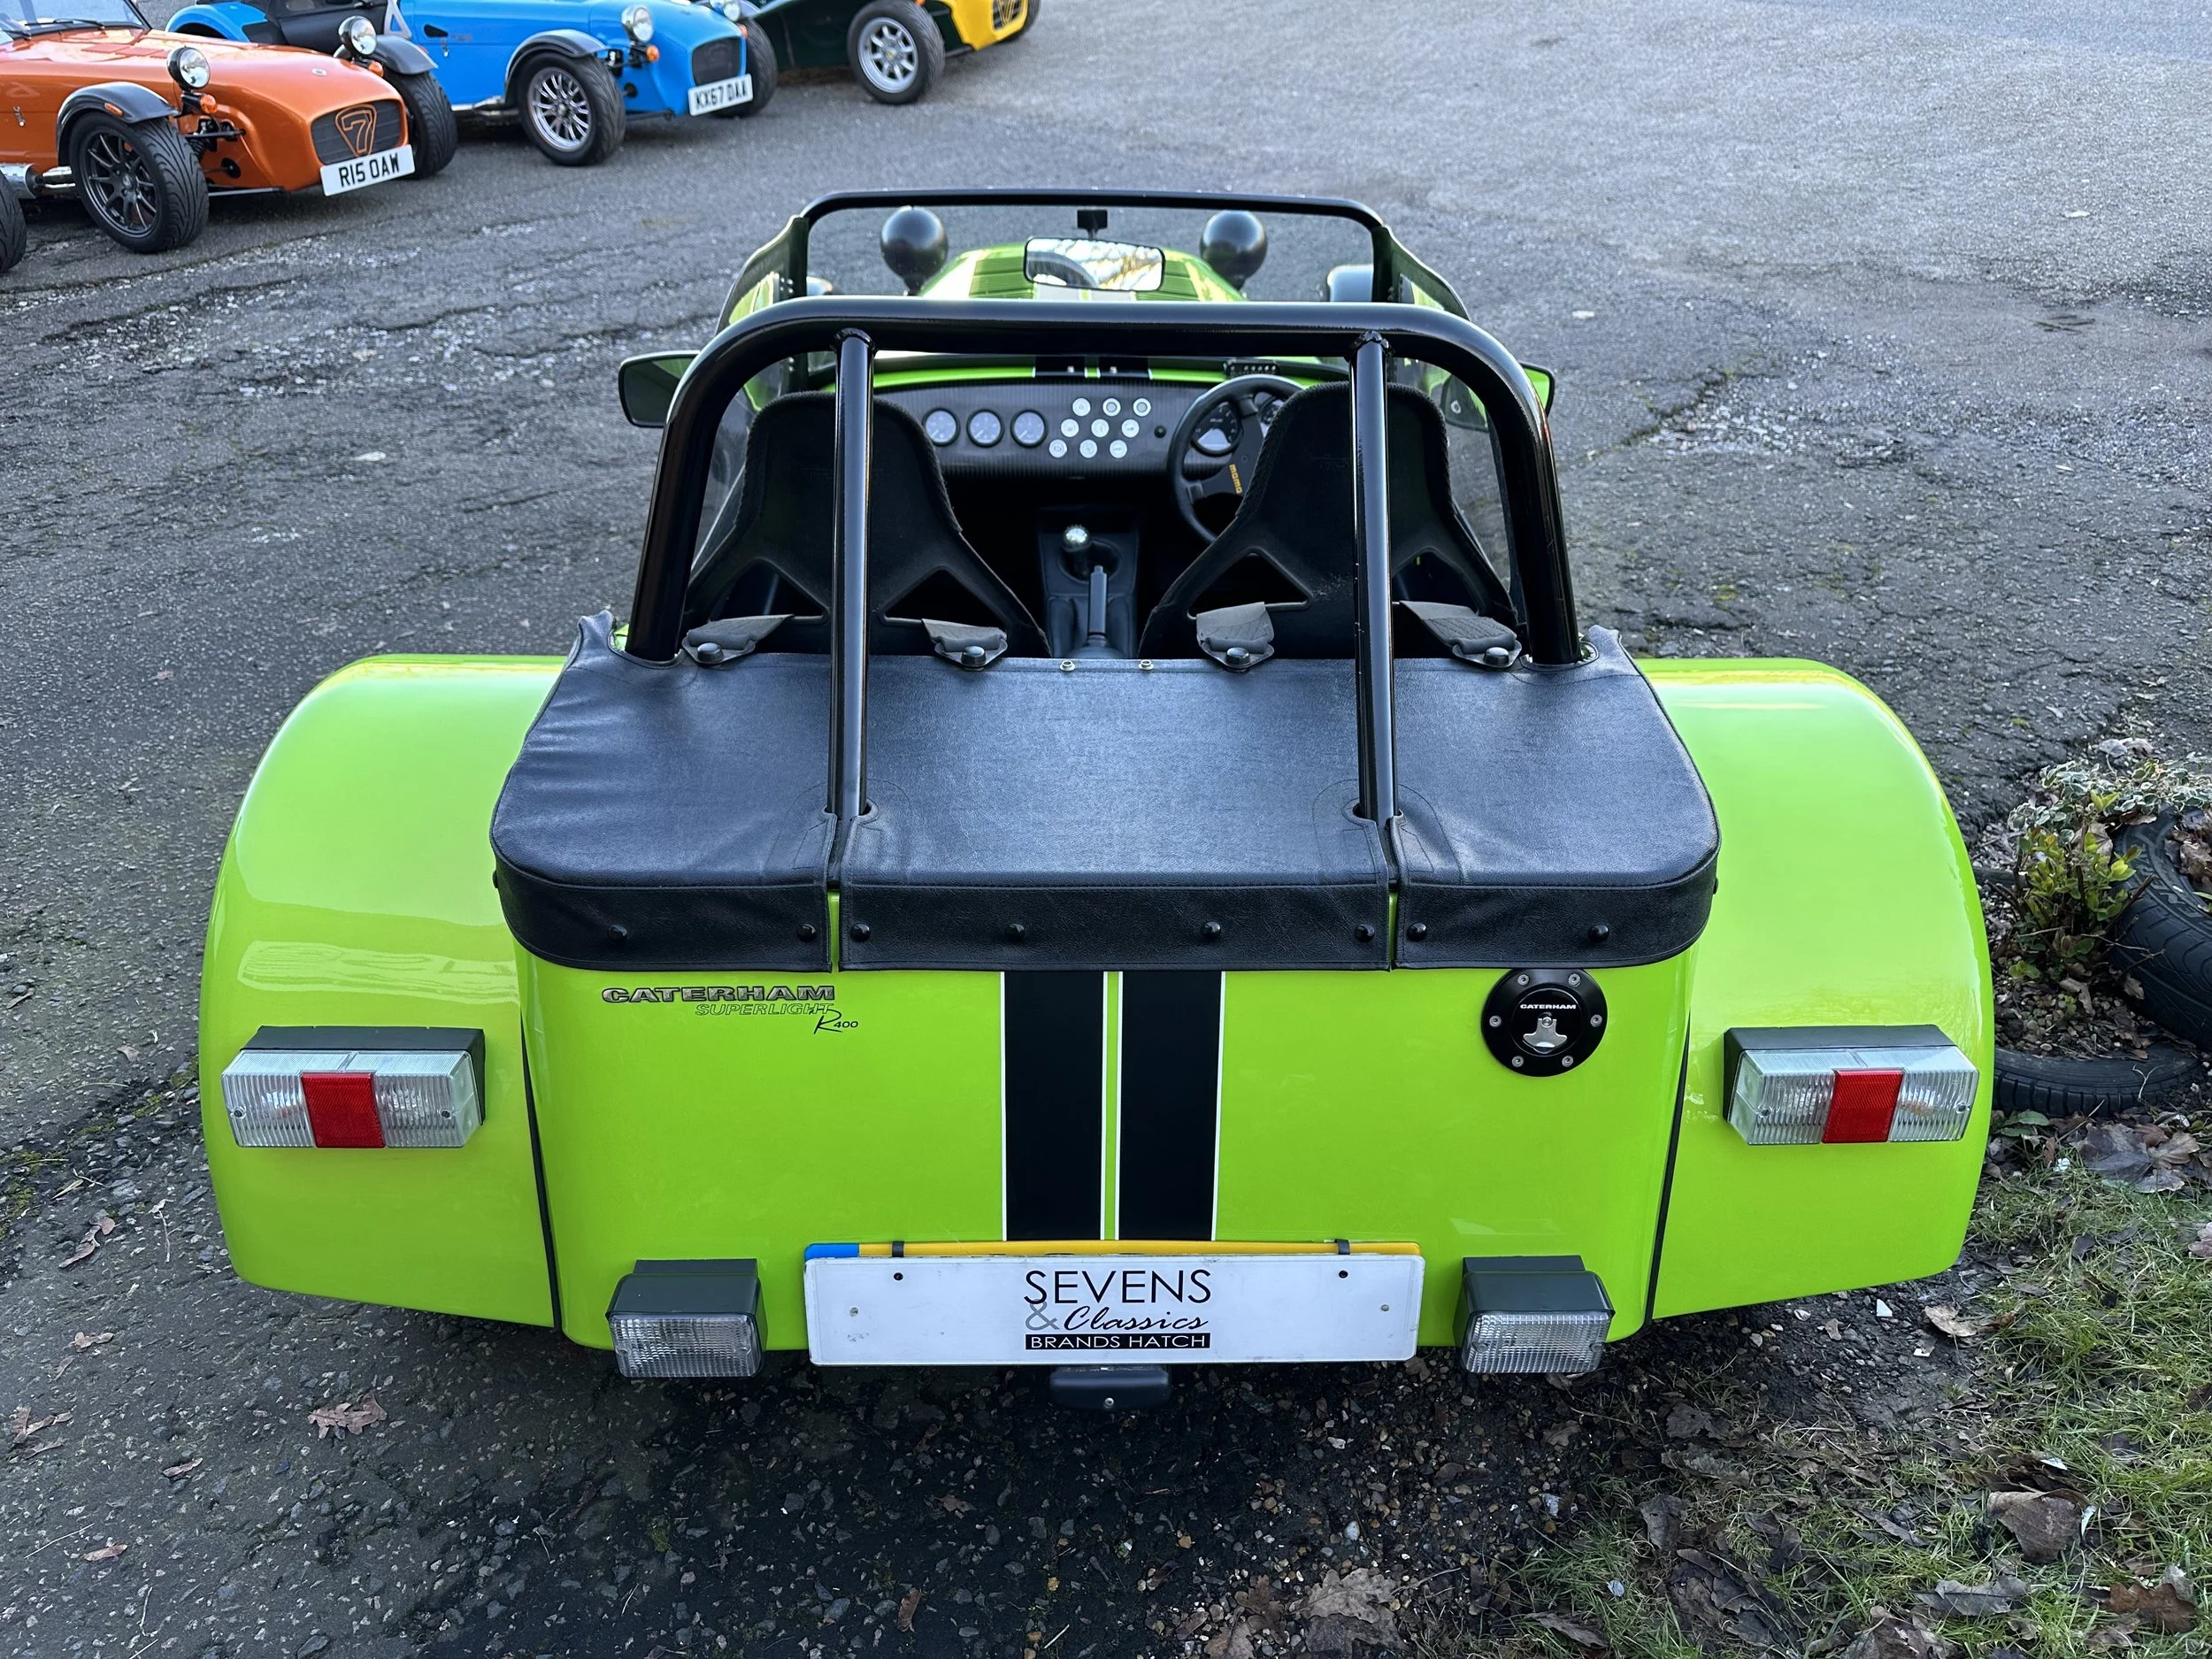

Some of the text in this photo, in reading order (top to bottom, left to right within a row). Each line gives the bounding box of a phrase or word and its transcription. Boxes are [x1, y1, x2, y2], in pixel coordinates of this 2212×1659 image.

[342, 110, 373, 154] 7
[339, 152, 400, 188] R15 OAW
[1229, 464, 1243, 495] momo
[602, 985, 835, 1002] CATERHAM
[695, 1002, 834, 1016] SUPERLIGHT
[1024, 1269, 1211, 1305] SEVENS
[1025, 1298, 1209, 1331] & Classics
[1031, 1334, 1205, 1348] BRANDS HATCH
